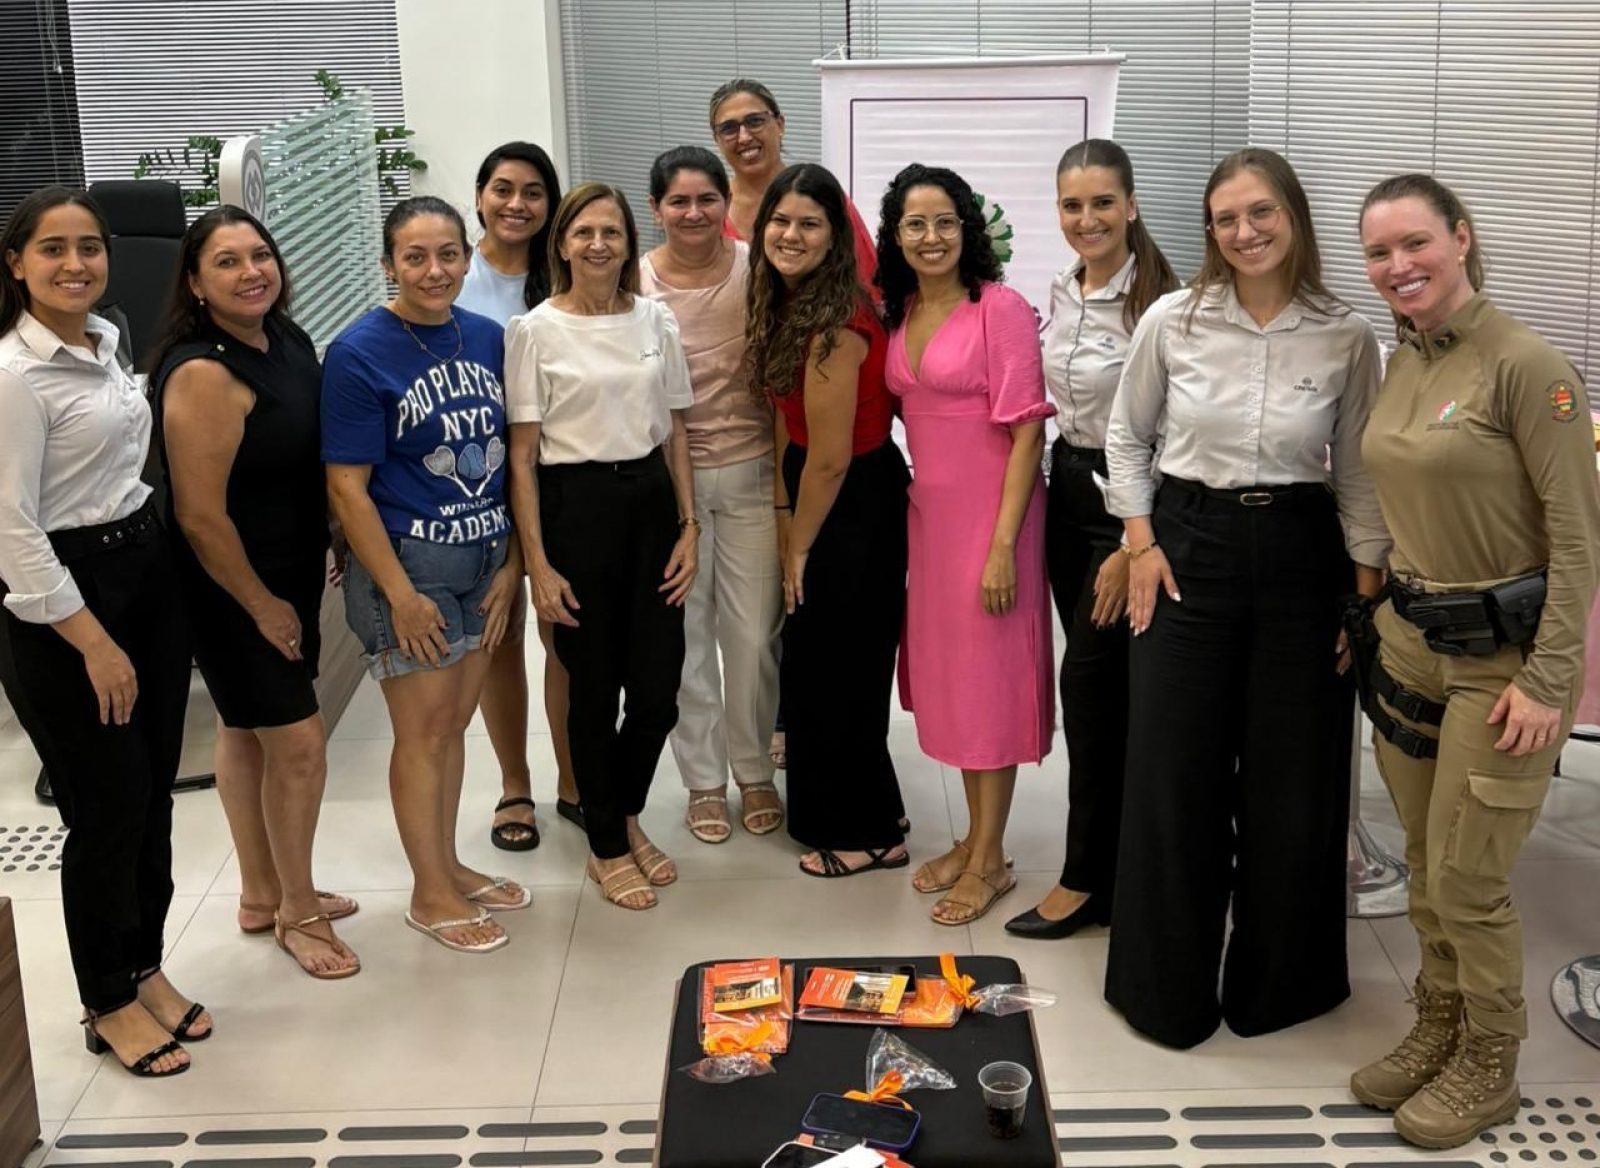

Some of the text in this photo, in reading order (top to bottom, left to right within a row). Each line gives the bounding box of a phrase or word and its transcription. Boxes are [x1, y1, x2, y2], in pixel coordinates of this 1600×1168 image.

[397, 377, 434, 439] PRO
[440, 406, 495, 441] NYC
[410, 504, 511, 544] ACADEM
